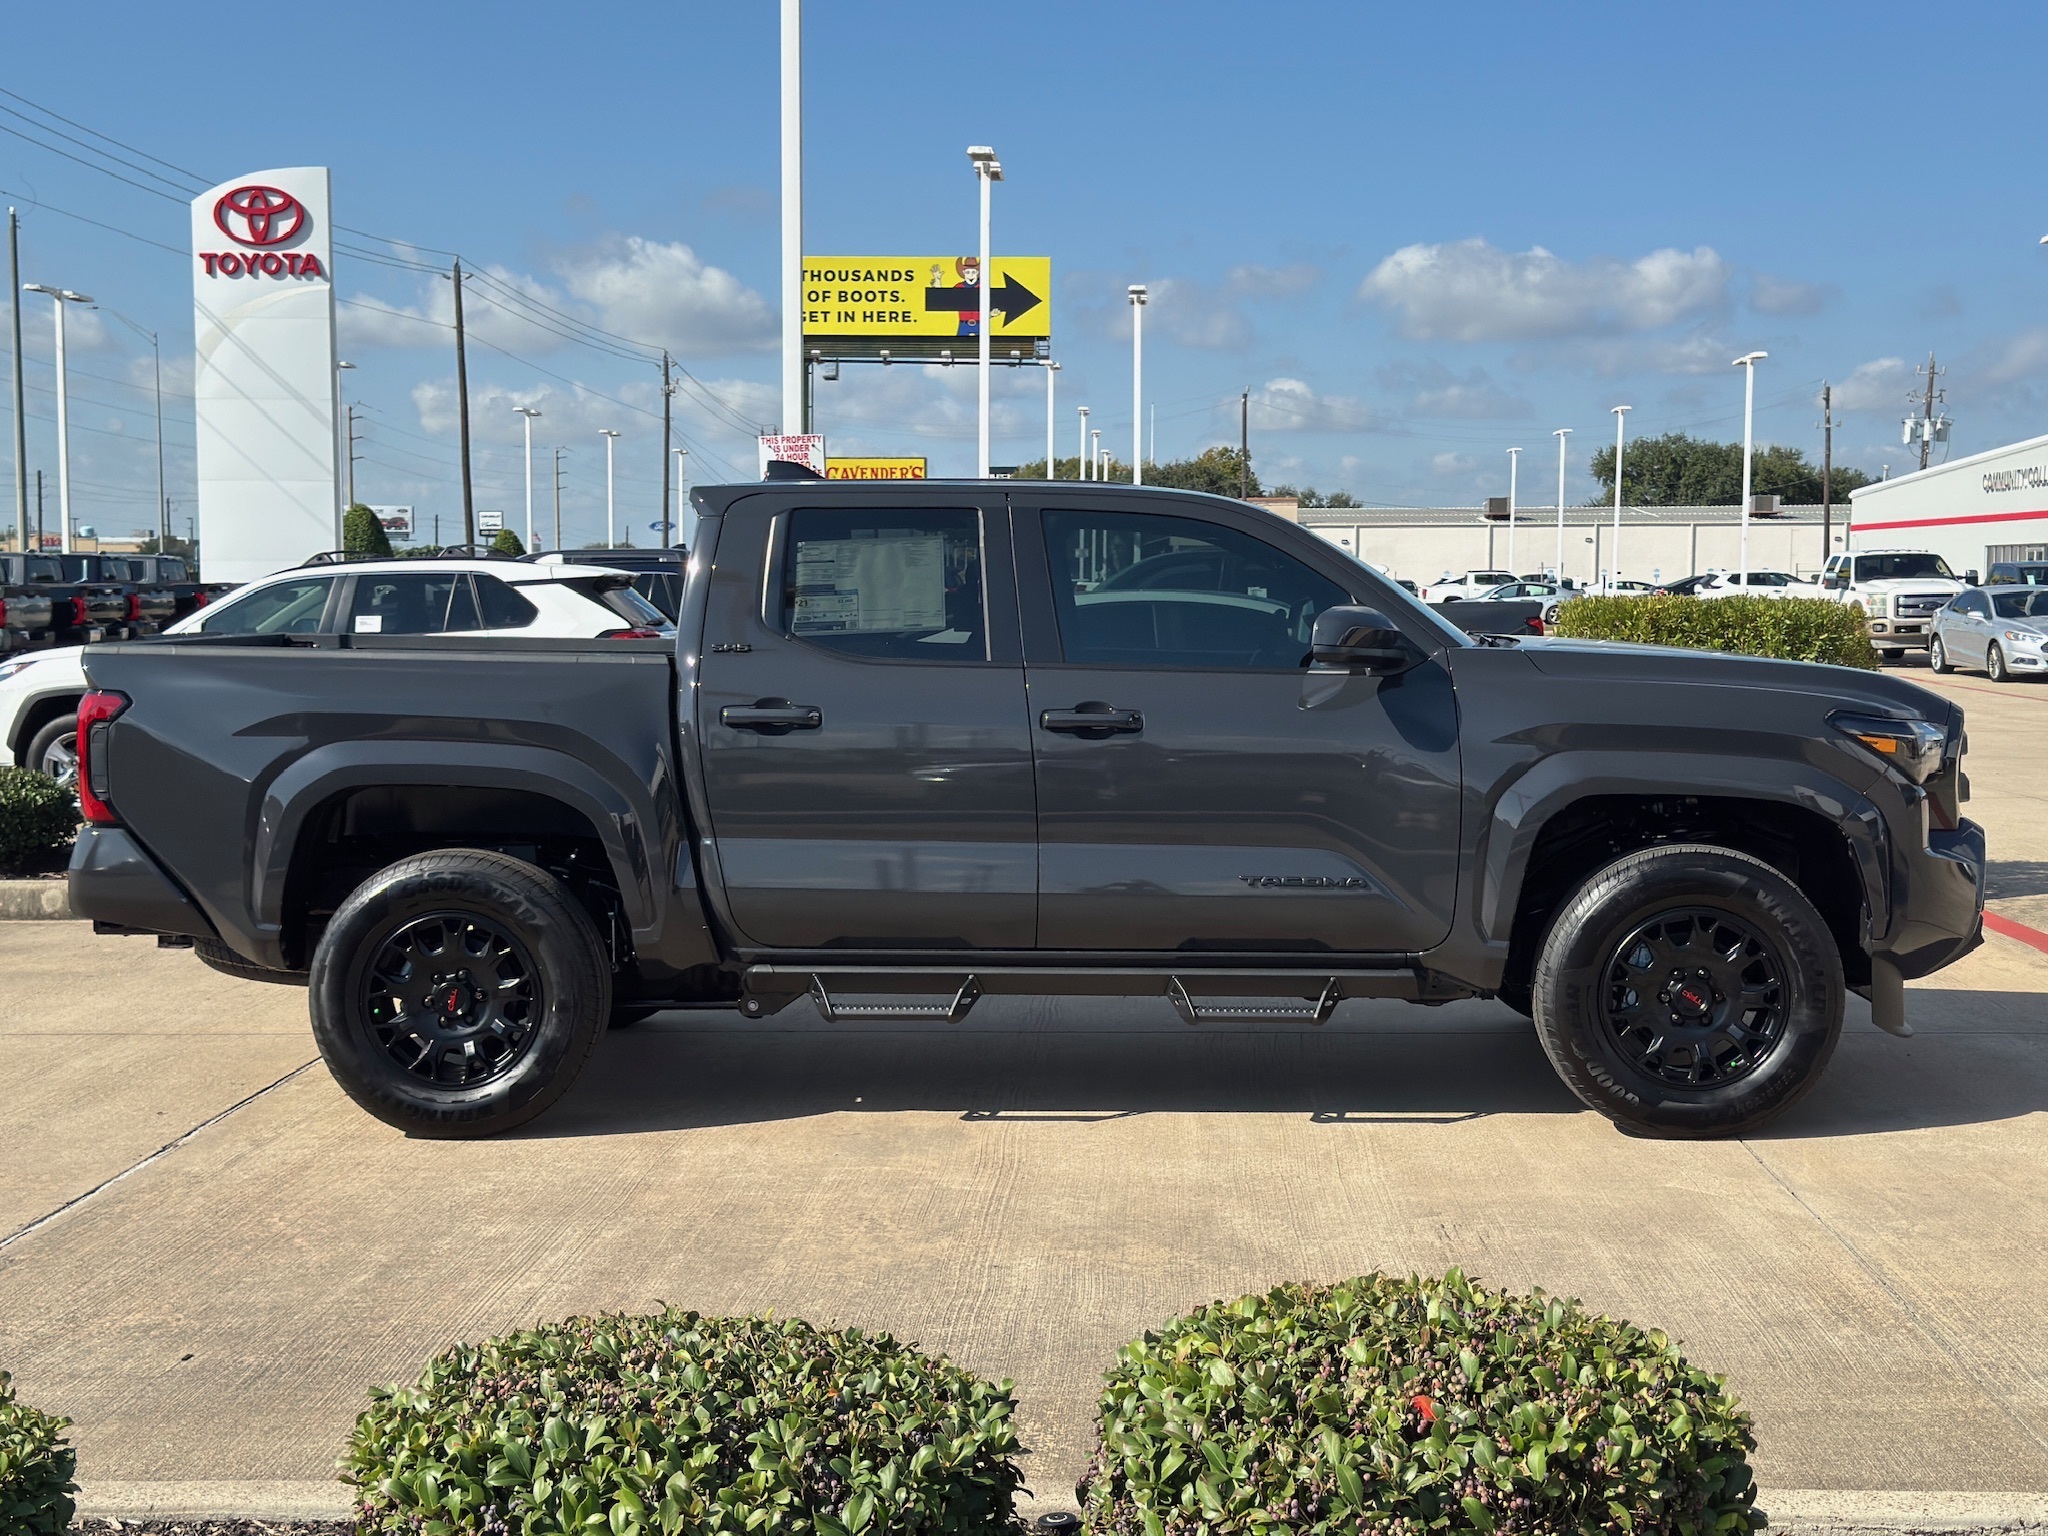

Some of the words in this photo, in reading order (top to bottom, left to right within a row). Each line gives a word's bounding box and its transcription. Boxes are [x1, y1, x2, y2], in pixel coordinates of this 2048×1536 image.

[199, 252, 322, 275] TOYOTA
[802, 270, 914, 282] THOUSANDS
[807, 290, 831, 302] OF
[838, 290, 905, 303] BOOTS.
[838, 311, 856, 323] IN
[863, 311, 918, 323] HERE.
[761, 437, 779, 445] THIS
[781, 435, 822, 444] PROPERTY
[773, 445, 781, 453] IS
[783, 444, 810, 453] UNDER
[787, 453, 809, 461] HOUR
[826, 465, 924, 479] CAVENDER'S
[1239, 875, 1371, 889] TACOMA
